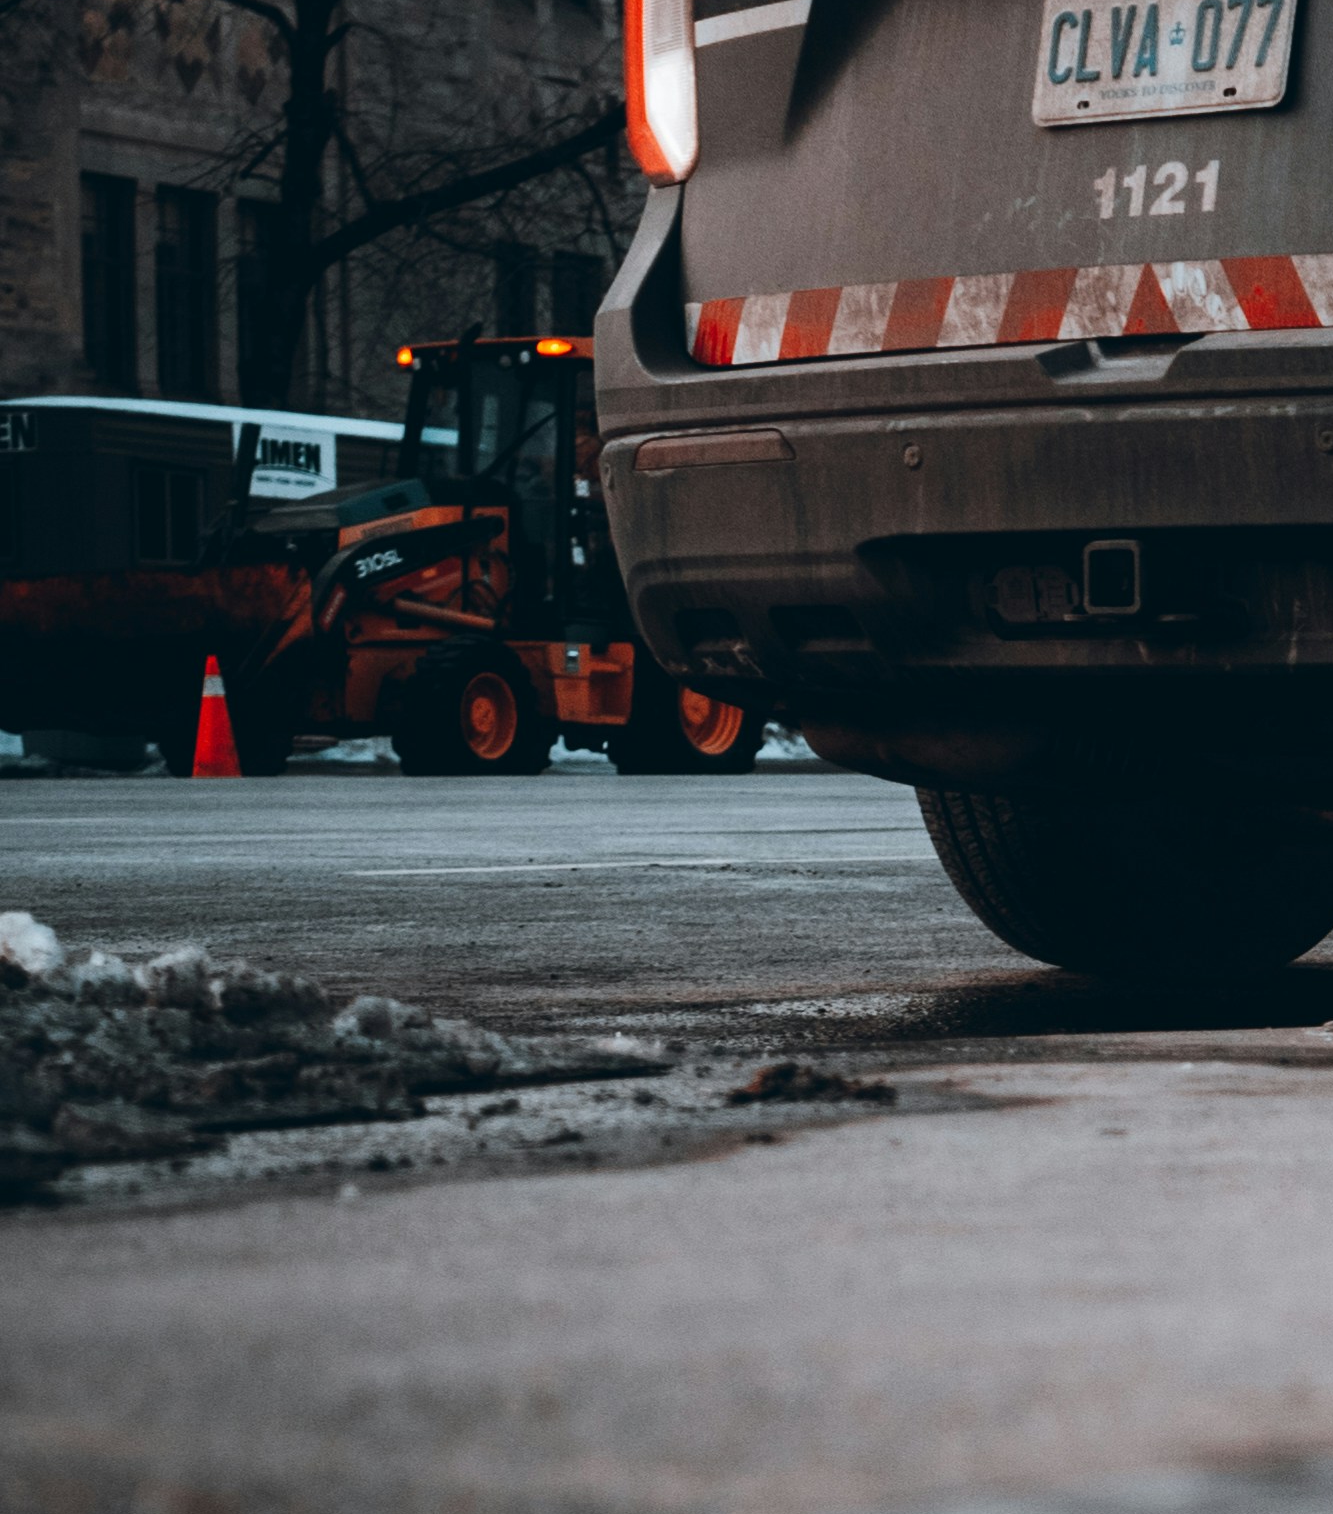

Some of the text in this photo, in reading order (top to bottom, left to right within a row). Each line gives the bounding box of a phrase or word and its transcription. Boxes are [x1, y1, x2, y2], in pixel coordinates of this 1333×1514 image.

[1047, 3, 1160, 84] CLVA
[1100, 79, 1217, 100] YOURS TO DISCOVER
[1091, 159, 1222, 222] 1121
